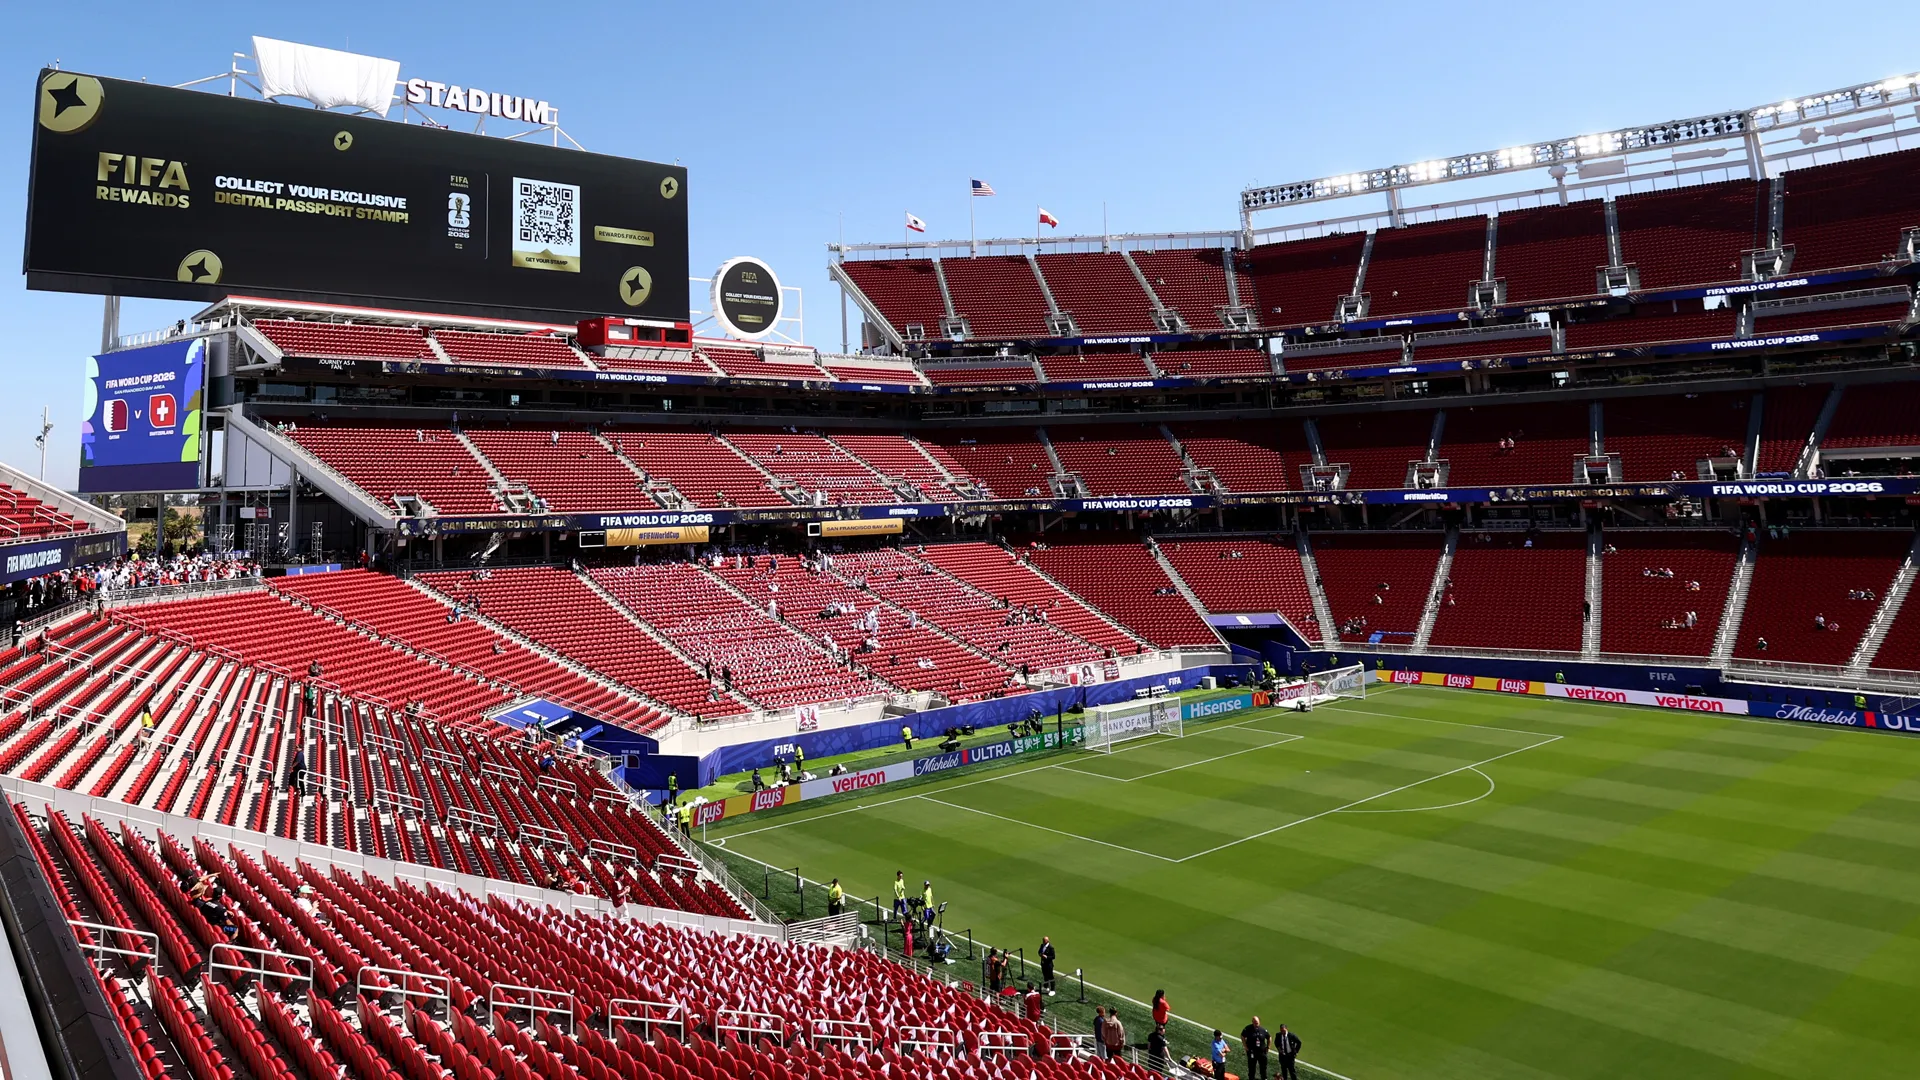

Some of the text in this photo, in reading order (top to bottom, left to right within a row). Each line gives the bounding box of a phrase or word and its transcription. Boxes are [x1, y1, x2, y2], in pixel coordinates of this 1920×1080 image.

[407, 78, 549, 124] STADIUM
[97, 151, 190, 191] FIFA
[450, 175, 469, 184] FIFA
[96, 185, 190, 208] REWARDS
[215, 175, 407, 209] COLLECT YOUR EXCLUSIVE
[214, 191, 409, 223] DIGITAL PASSPORT STAMP!
[539, 209, 554, 217] FIFA
[598, 230, 650, 242] REWARDS.FIFA.COM
[742, 271, 757, 280] FIFA
[1725, 285, 1757, 293] WORLD
[1776, 278, 1808, 288] 2026
[1732, 339, 1765, 348] WORLD
[1785, 334, 1819, 343] 2026
[105, 371, 176, 389] FIFA WORLD CUP 2026
[610, 373, 632, 381] WORLD
[633, 374, 646, 382] CUP
[1529, 490, 1551, 498] SAN
[1640, 487, 1669, 495] AREA
[1712, 482, 1883, 495] FIFA WORLD CUP 2026
[1082, 498, 1192, 509] FIFA WORLD CUP 2026
[442, 521, 463, 531] SAN
[542, 519, 566, 528] AREA
[600, 513, 713, 527] FIFA WORLD CUP 2026
[638, 531, 680, 540] #FIFAWorldCup
[6, 555, 19, 574] FIFA
[19, 552, 37, 570] WORLD
[37, 550, 47, 567] CUP
[46, 548, 62, 565] 2026
[1168, 676, 1182, 686] FIFA
[1395, 670, 1419, 683] Lay's
[1447, 674, 1471, 688] Lay's
[1649, 671, 1676, 681] FIFA
[1277, 682, 1320, 700] cDonald's
[1501, 678, 1526, 693] Lay's
[1565, 686, 1627, 703] verizon
[1190, 699, 1242, 718] Hisense
[1655, 695, 1723, 712] verizon
[1775, 703, 1920, 732] Michelob UL
[1102, 721, 1124, 733] BANK
[1125, 719, 1135, 728] OF
[774, 743, 795, 756] FIFA
[915, 742, 1012, 776] Michelob ULTRA
[832, 770, 886, 793] verizon
[755, 788, 782, 810] Lay's
